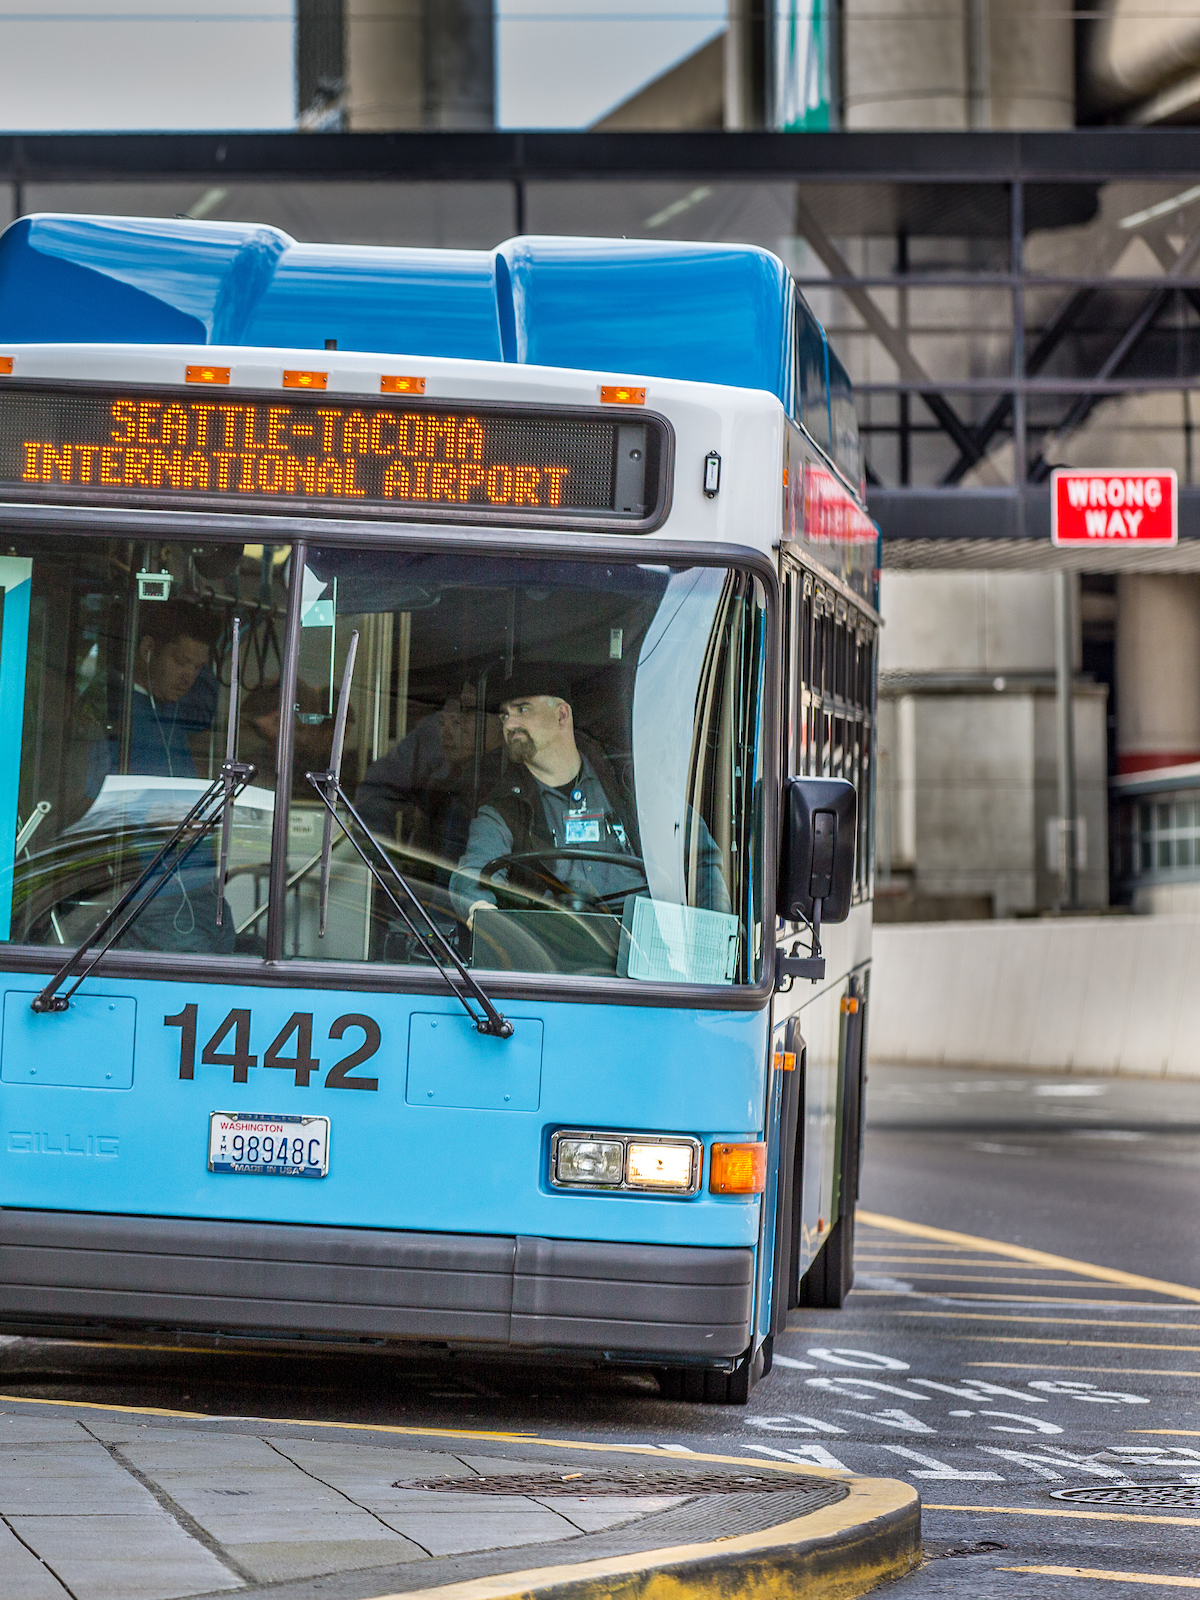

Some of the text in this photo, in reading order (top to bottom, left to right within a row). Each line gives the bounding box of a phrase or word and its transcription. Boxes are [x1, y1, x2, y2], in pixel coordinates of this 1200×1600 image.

[111, 401, 483, 459] SEATTLE-TACOMA
[22, 442, 568, 505] INTERNATIONAL AIRPORT
[1067, 478, 1162, 508] WRONG
[1085, 509, 1144, 538] WAY
[163, 1003, 382, 1092] 1442
[220, 1122, 284, 1133] WASHINGTON
[7, 1130, 119, 1158] GILLIG
[232, 1135, 320, 1166] 98948C
[234, 1163, 300, 1175] MADE IN USA
